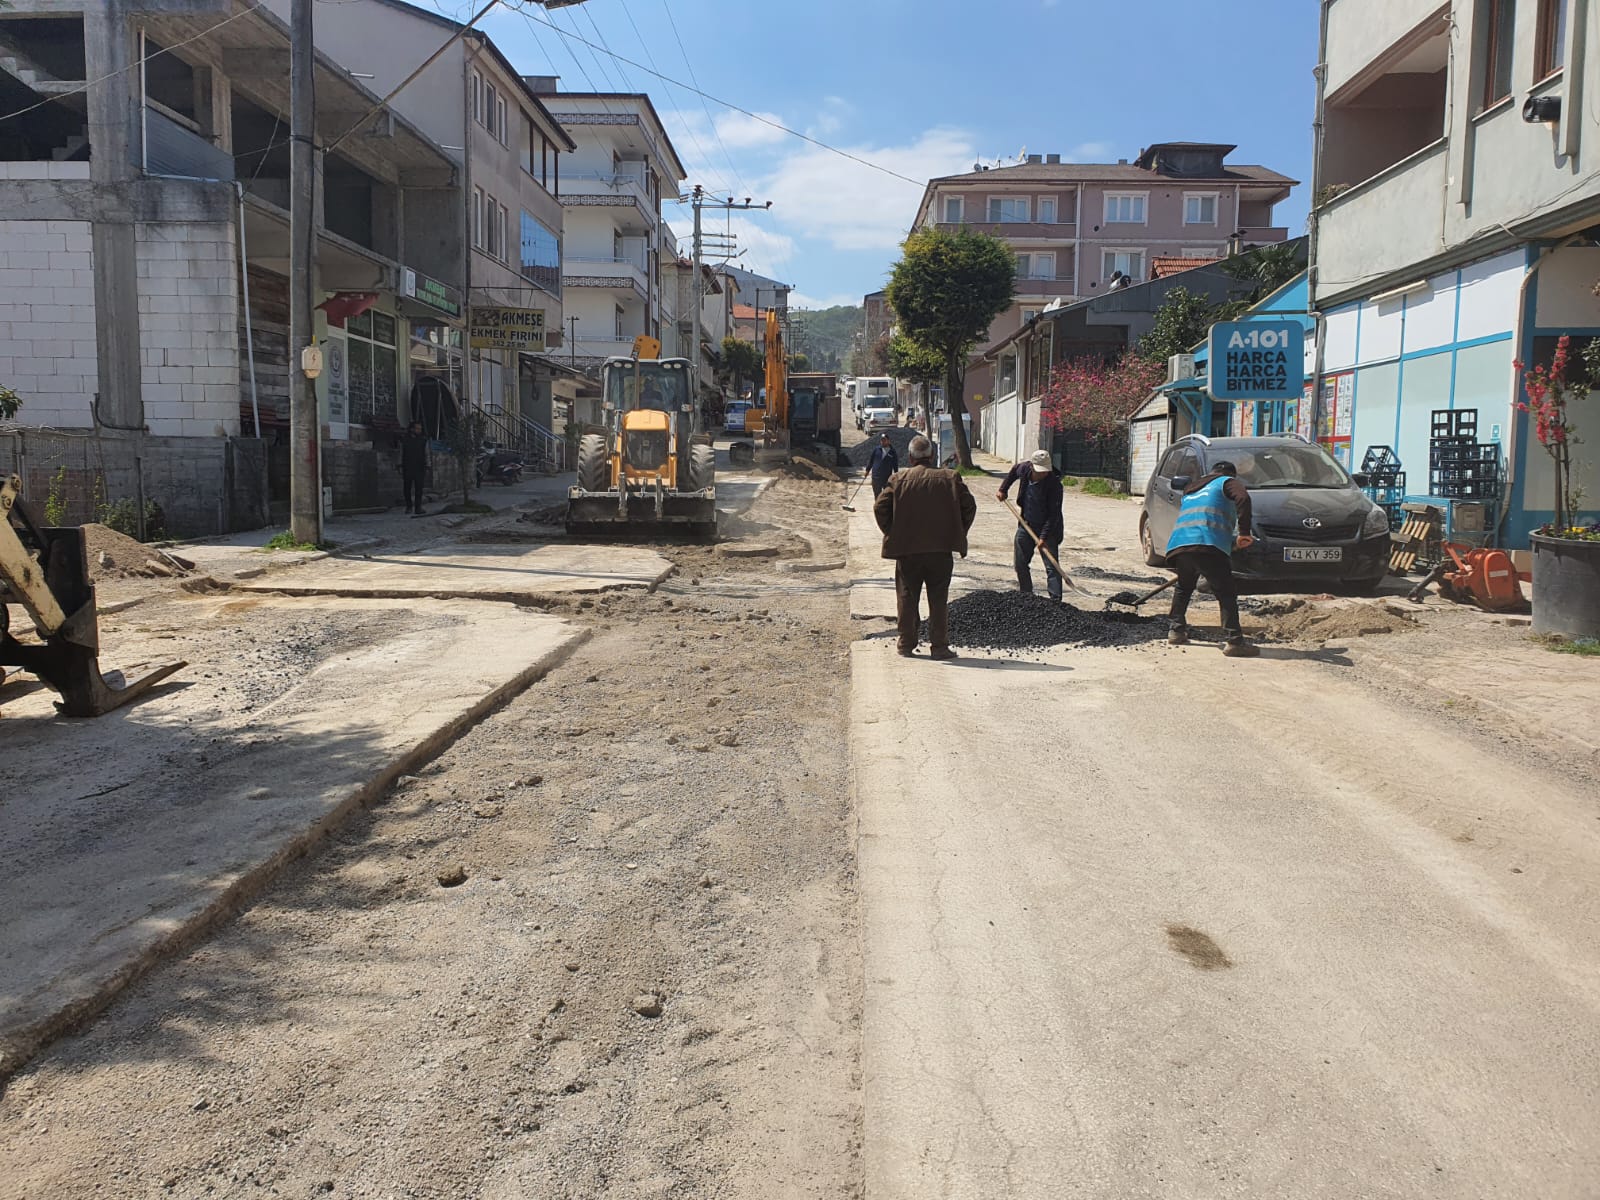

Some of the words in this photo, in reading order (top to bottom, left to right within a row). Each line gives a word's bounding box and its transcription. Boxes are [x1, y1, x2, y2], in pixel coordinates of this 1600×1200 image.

[471, 328, 506, 339] EKMEK
[510, 330, 542, 341] FIRINI
[1227, 351, 1287, 364] HARCA
[1227, 364, 1287, 377] HARCA
[1291, 550, 1302, 559] 41
[1305, 550, 1320, 560] KY
[1322, 550, 1340, 559] 359
